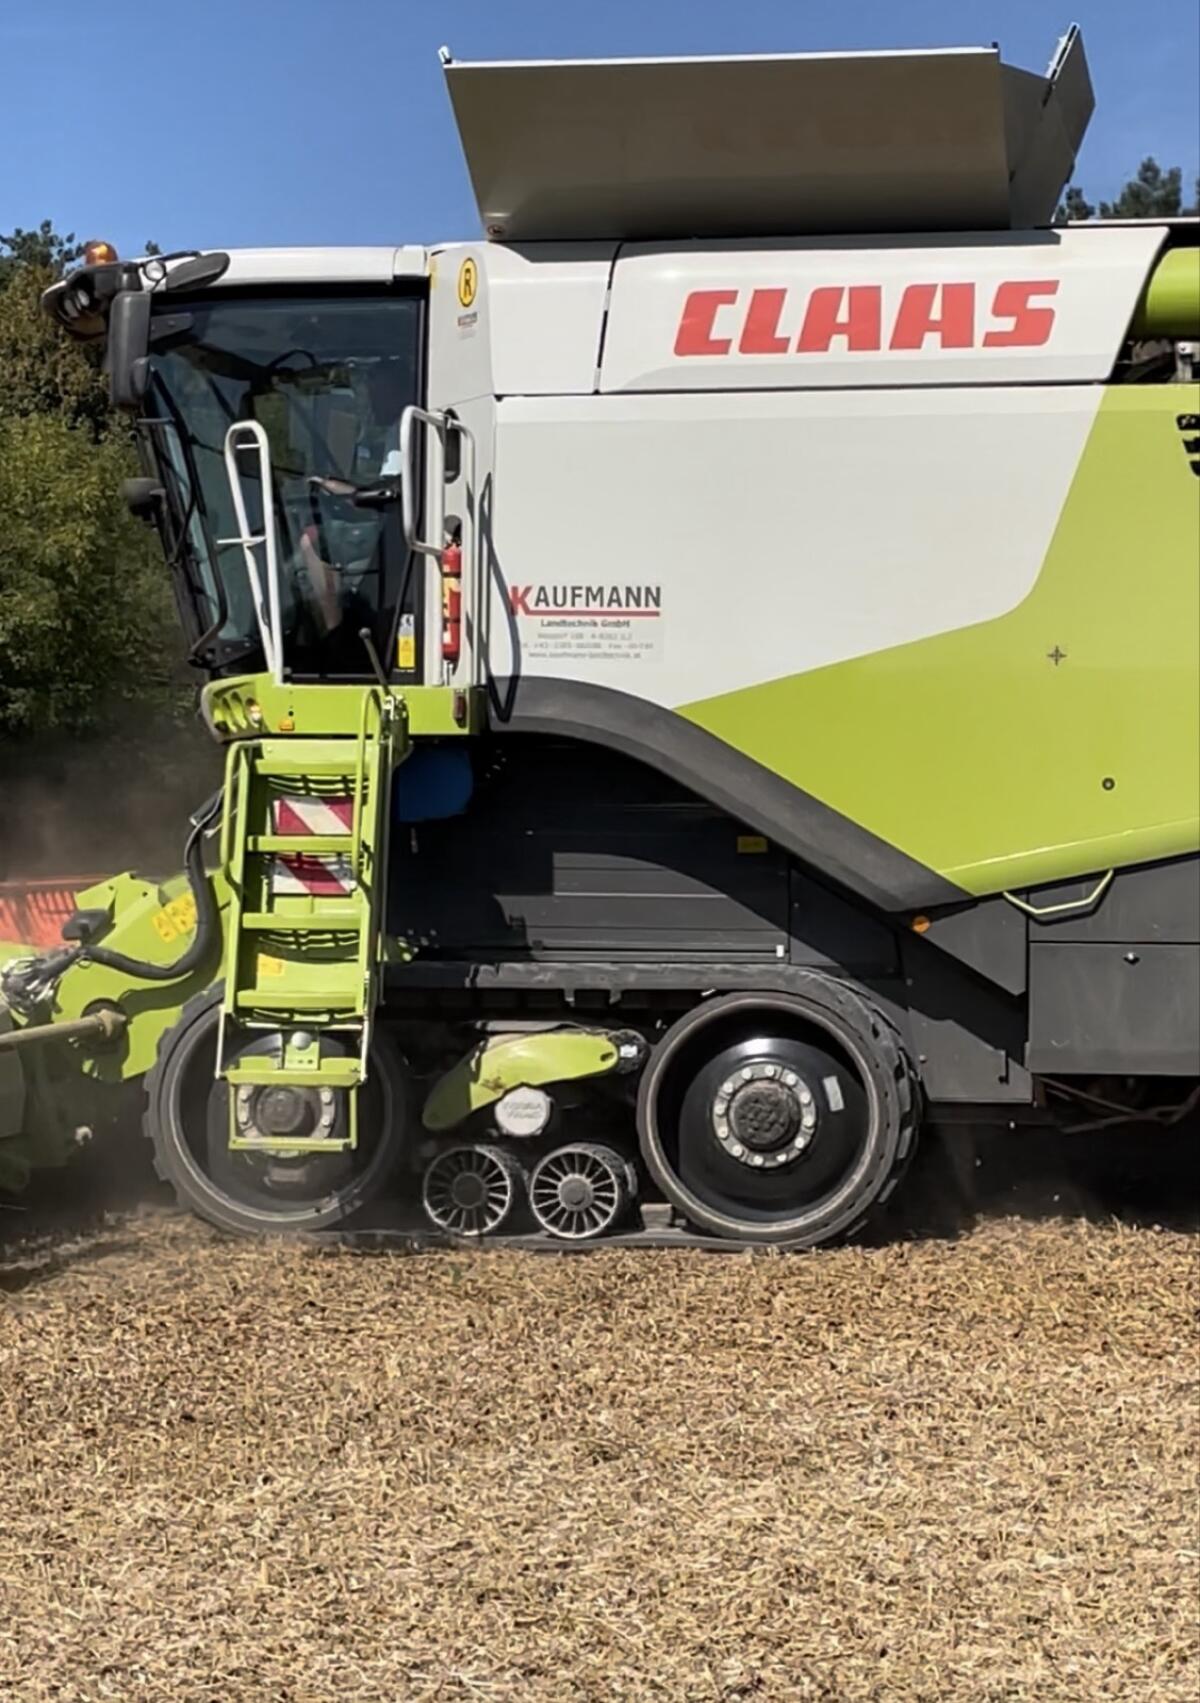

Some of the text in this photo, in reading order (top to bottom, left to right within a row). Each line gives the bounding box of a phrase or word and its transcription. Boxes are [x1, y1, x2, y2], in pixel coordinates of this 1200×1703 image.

[463, 267, 473, 298] R
[673, 279, 1060, 356] CLAAS
[510, 584, 661, 616] KAUFMANN
[601, 618, 630, 628] GmbH
